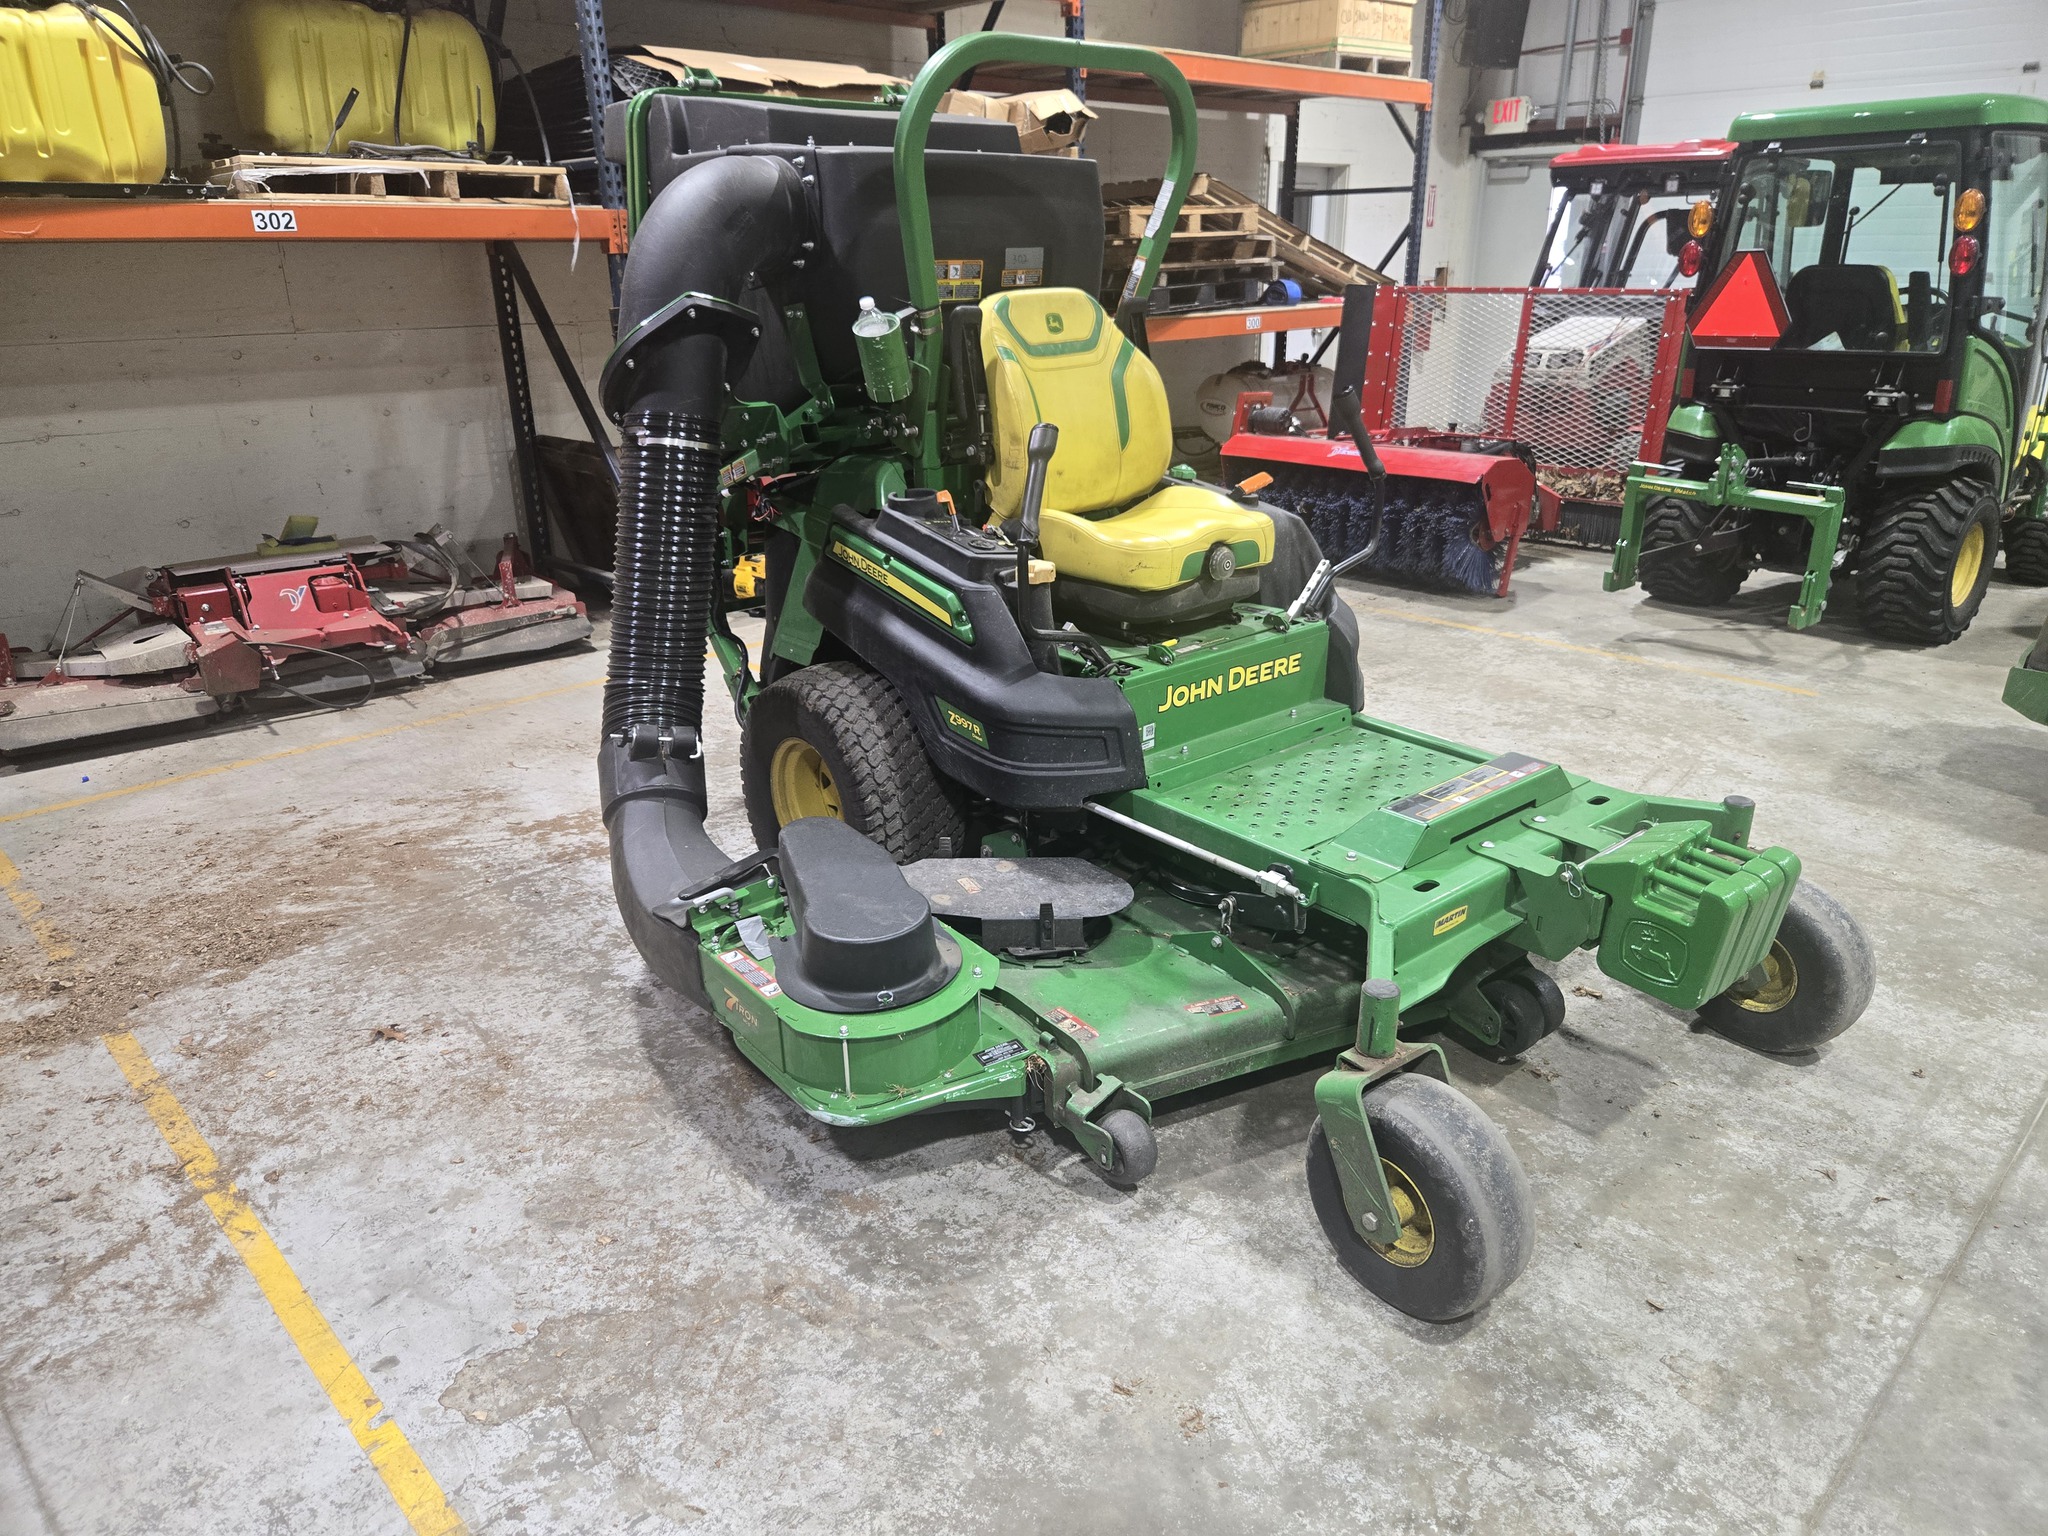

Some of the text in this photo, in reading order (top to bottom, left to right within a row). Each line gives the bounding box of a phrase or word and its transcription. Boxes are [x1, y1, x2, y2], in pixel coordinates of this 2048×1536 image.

[1492, 98, 1521, 124] EXIT
[254, 212, 296, 230] 302
[1246, 318, 1260, 328] 300
[838, 545, 889, 586] JOHN DEERE
[1158, 653, 1302, 713] JOHN DEERE
